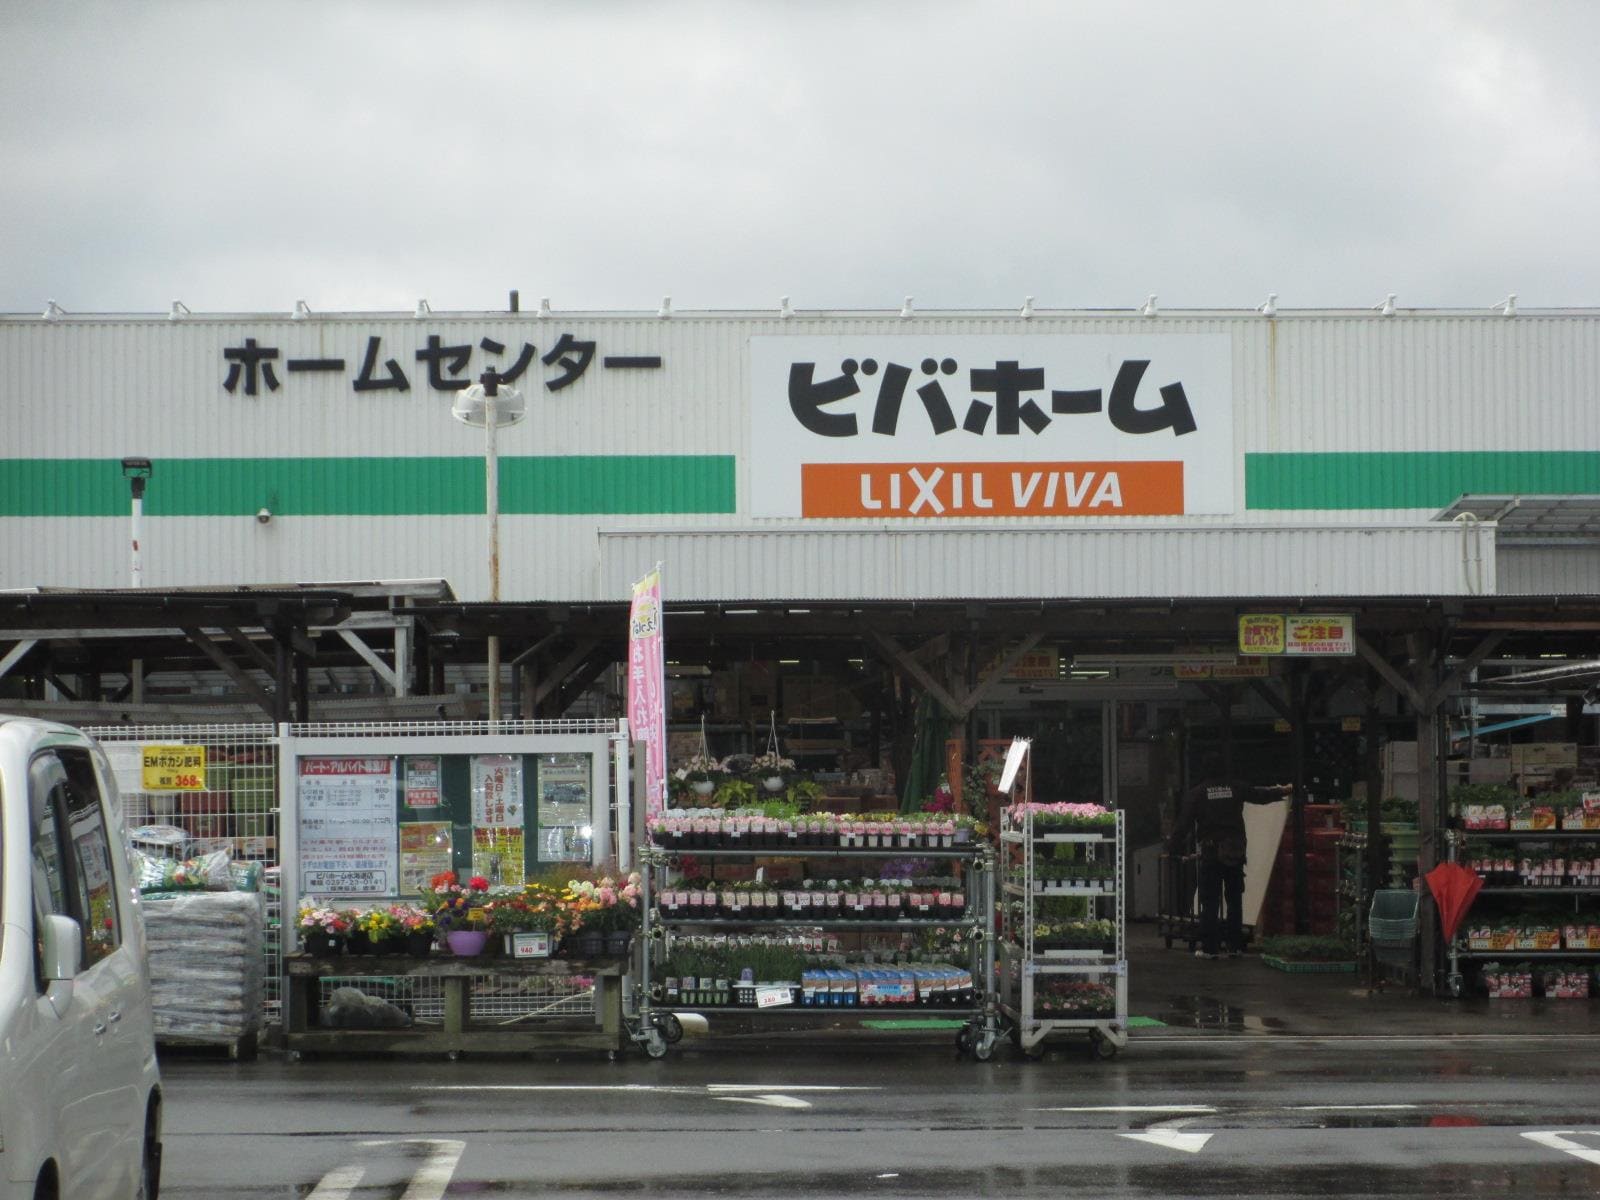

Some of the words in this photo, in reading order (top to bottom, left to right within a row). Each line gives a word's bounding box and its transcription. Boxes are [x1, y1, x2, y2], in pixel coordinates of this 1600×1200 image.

[222, 333, 662, 395] ホームセンター
[788, 358, 1198, 437] ビバホーム
[860, 467, 993, 515] LIXIL
[1011, 472, 1124, 508] VIVA
[1292, 625, 1344, 640] ご注目
[143, 756, 201, 768] EMボカシ肥料
[175, 775, 197, 787] 368
